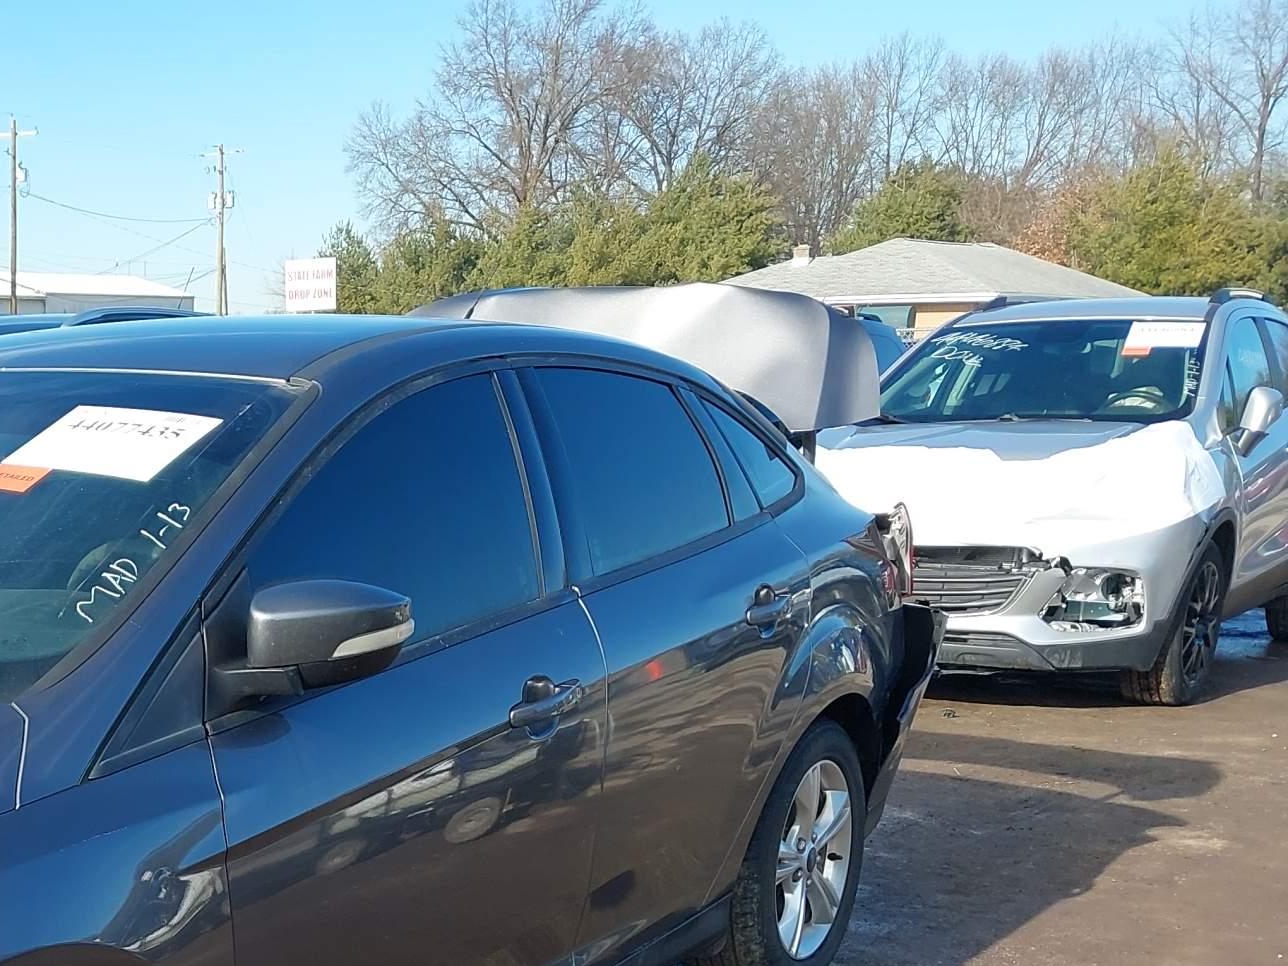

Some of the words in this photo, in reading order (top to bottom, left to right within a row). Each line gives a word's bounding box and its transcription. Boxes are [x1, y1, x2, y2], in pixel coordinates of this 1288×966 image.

[287, 271, 309, 281] STATE
[312, 269, 333, 280] FARM
[288, 289, 310, 300] DROP
[313, 287, 333, 298] ZONE
[67, 419, 187, 439] 44077435
[76, 558, 138, 623] MAD
[139, 503, 191, 549] 1-13
